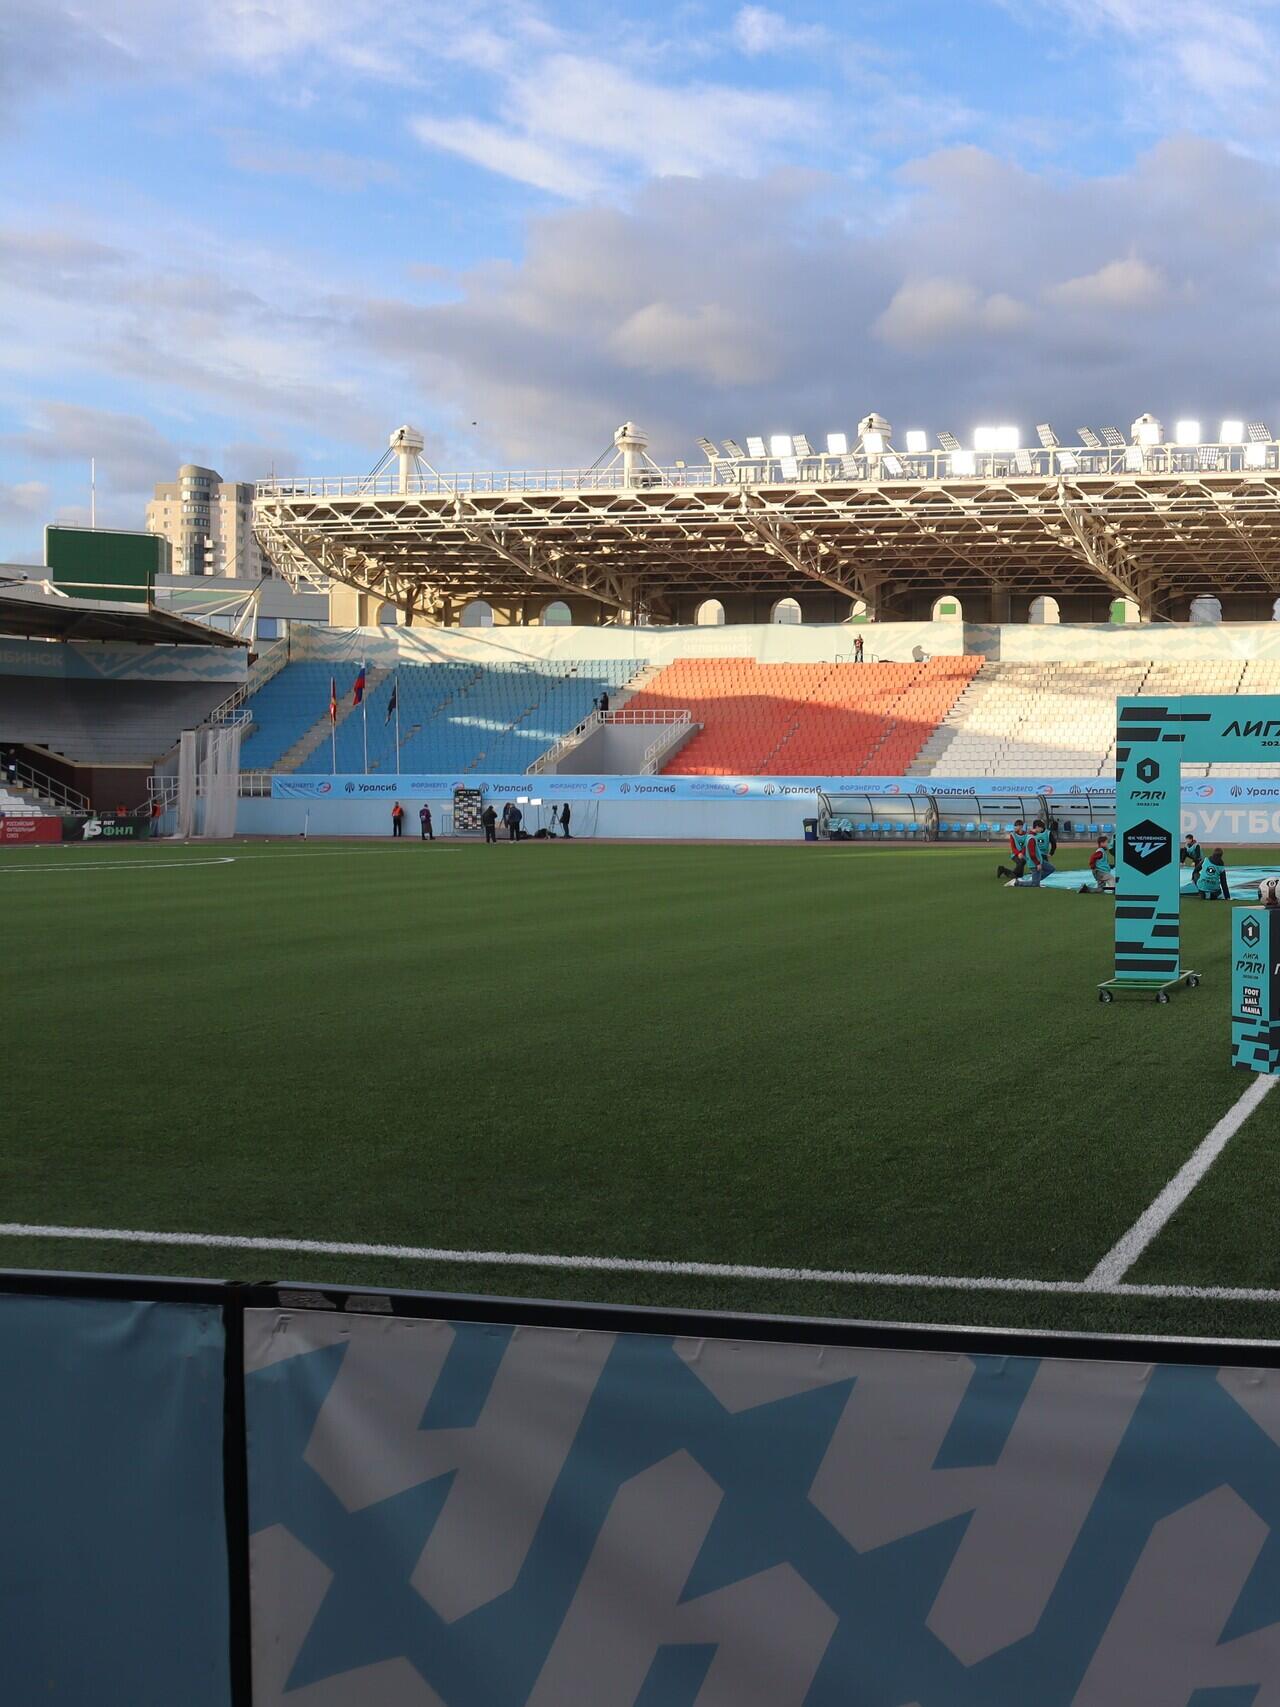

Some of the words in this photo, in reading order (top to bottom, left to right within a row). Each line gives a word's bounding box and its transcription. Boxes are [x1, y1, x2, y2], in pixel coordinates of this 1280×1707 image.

[1142, 764, 1152, 777] 1
[358, 783, 397, 792] Уралсиб
[493, 783, 533, 792] Уралсиб
[634, 784, 676, 793] Уралсиб
[779, 785, 822, 795] Уралсиб
[1130, 790, 1167, 800] PARI
[103, 826, 133, 836] ФНЛ
[1247, 926, 1253, 937] 1
[1243, 952, 1259, 960] ЛИГА
[1236, 961, 1265, 974] PARI
[1244, 988, 1259, 997] FOOT
[1245, 996, 1258, 1005] BALL
[1242, 1006, 1260, 1015] MANIA
